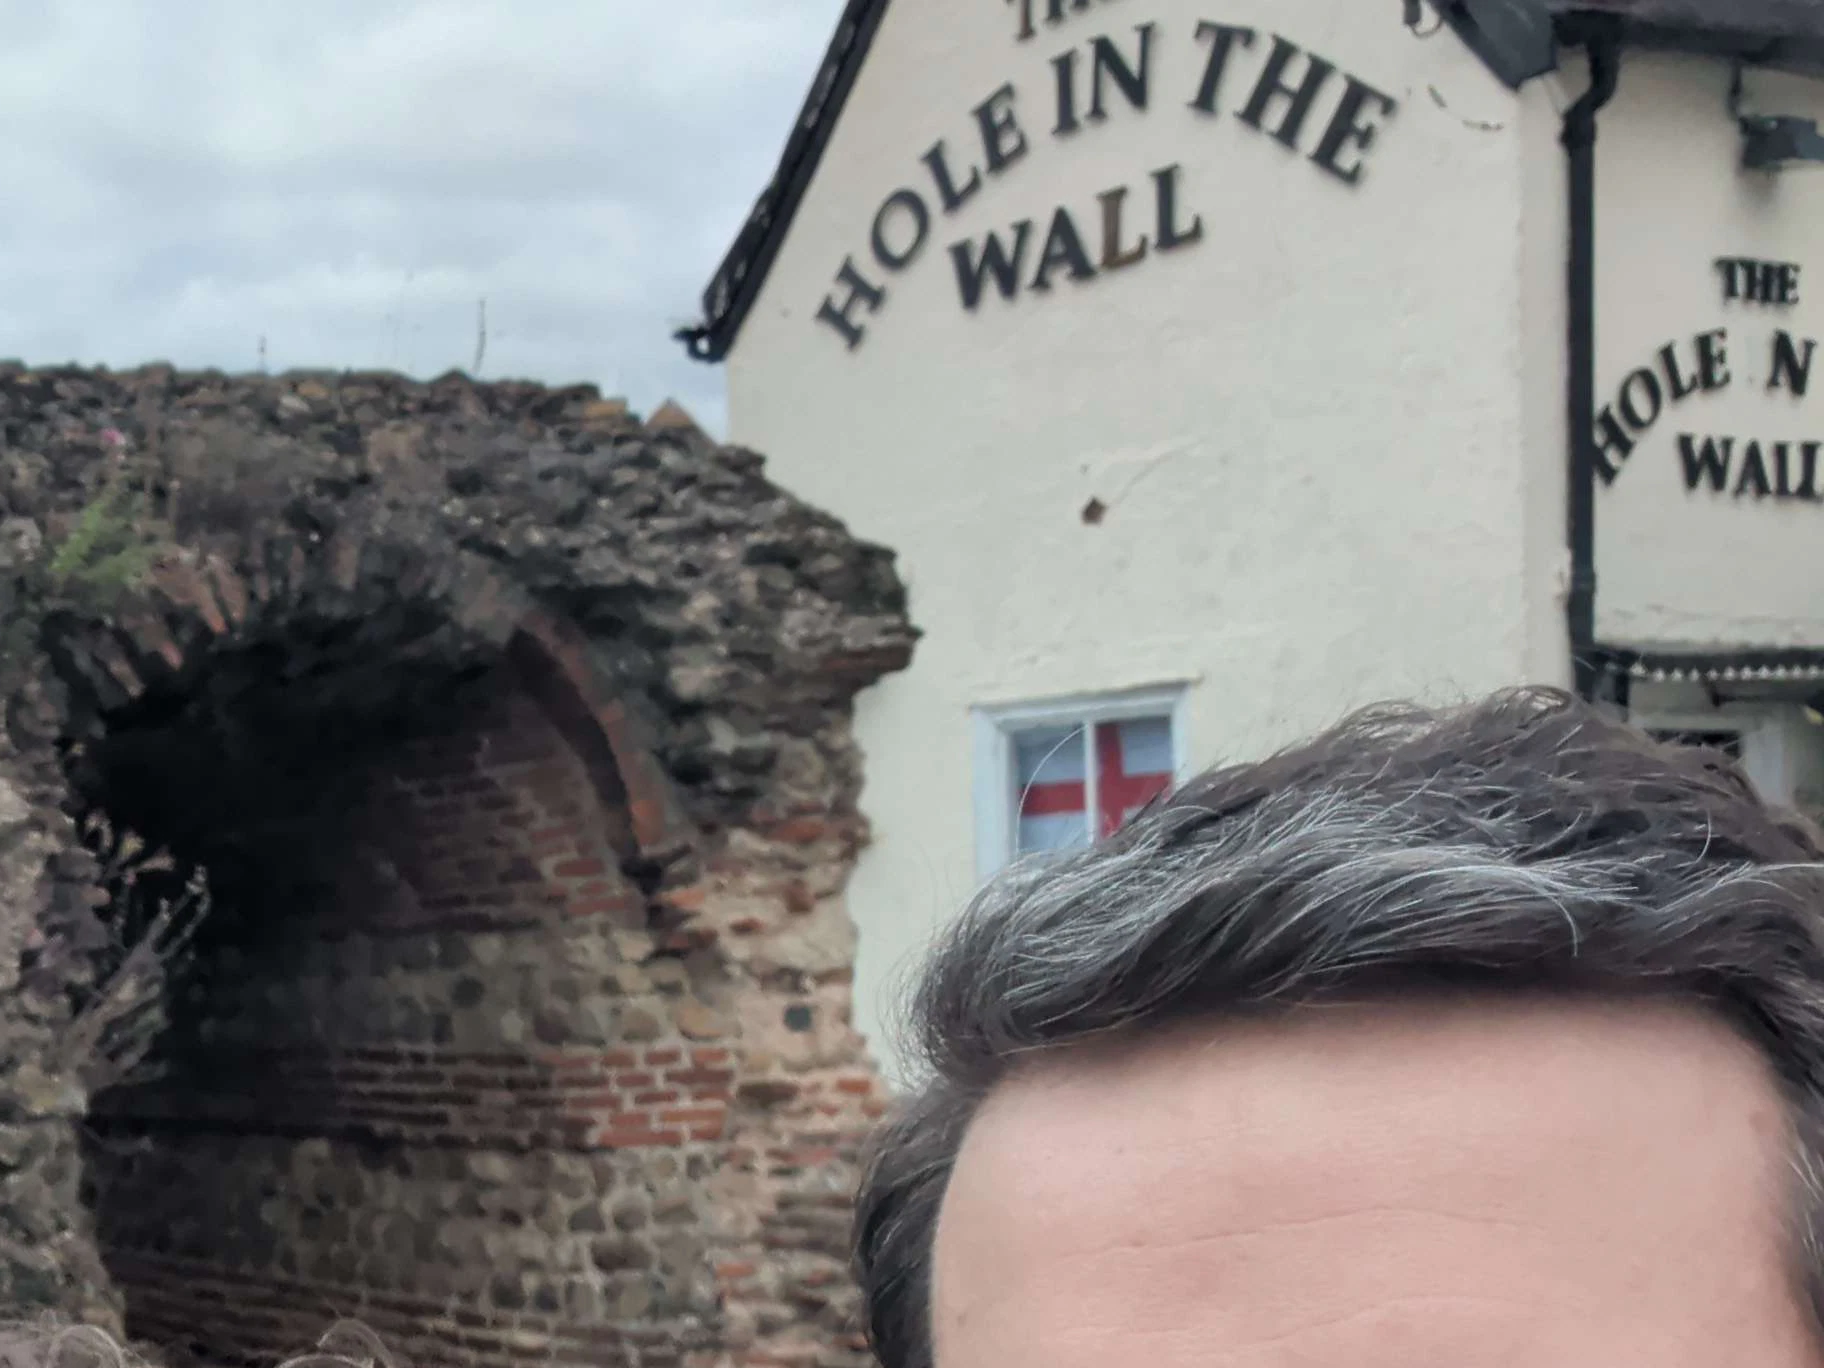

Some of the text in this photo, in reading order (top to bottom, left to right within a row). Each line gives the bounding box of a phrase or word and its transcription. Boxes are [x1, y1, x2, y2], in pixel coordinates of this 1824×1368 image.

[815, 20, 1397, 350] HOLE IN THE
[946, 164, 1203, 310] WALL
[1714, 257, 1801, 304] THE
[1591, 328, 1817, 486] HOLE N
